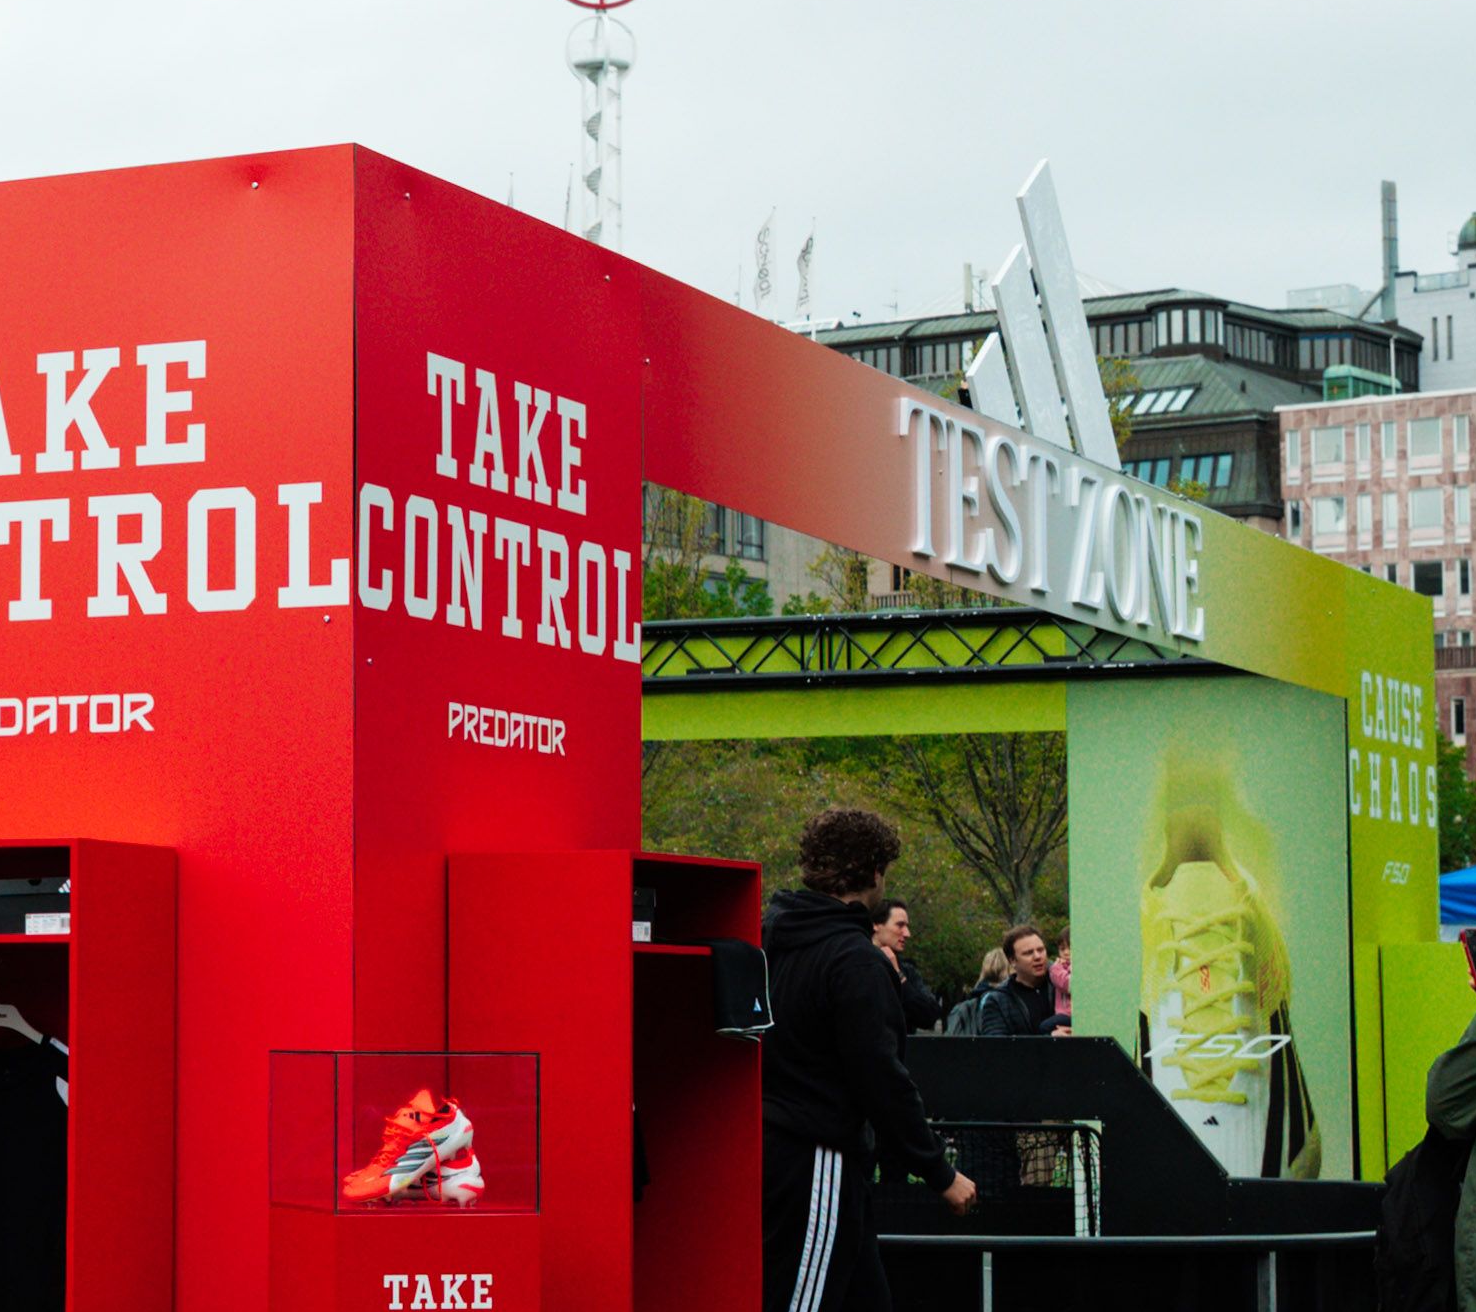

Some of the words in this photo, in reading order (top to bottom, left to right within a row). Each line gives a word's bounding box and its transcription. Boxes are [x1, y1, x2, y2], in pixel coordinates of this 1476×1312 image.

[426, 350, 587, 517] TAKE
[899, 397, 1060, 593] TEST
[1065, 466, 1205, 642] ZONE
[357, 481, 642, 664] CONTROL
[447, 701, 566, 757] PREDATOR
[1360, 669, 1424, 750] CAUSE
[1349, 747, 1438, 829] CHAOS
[383, 1273, 493, 1311] TAKE
